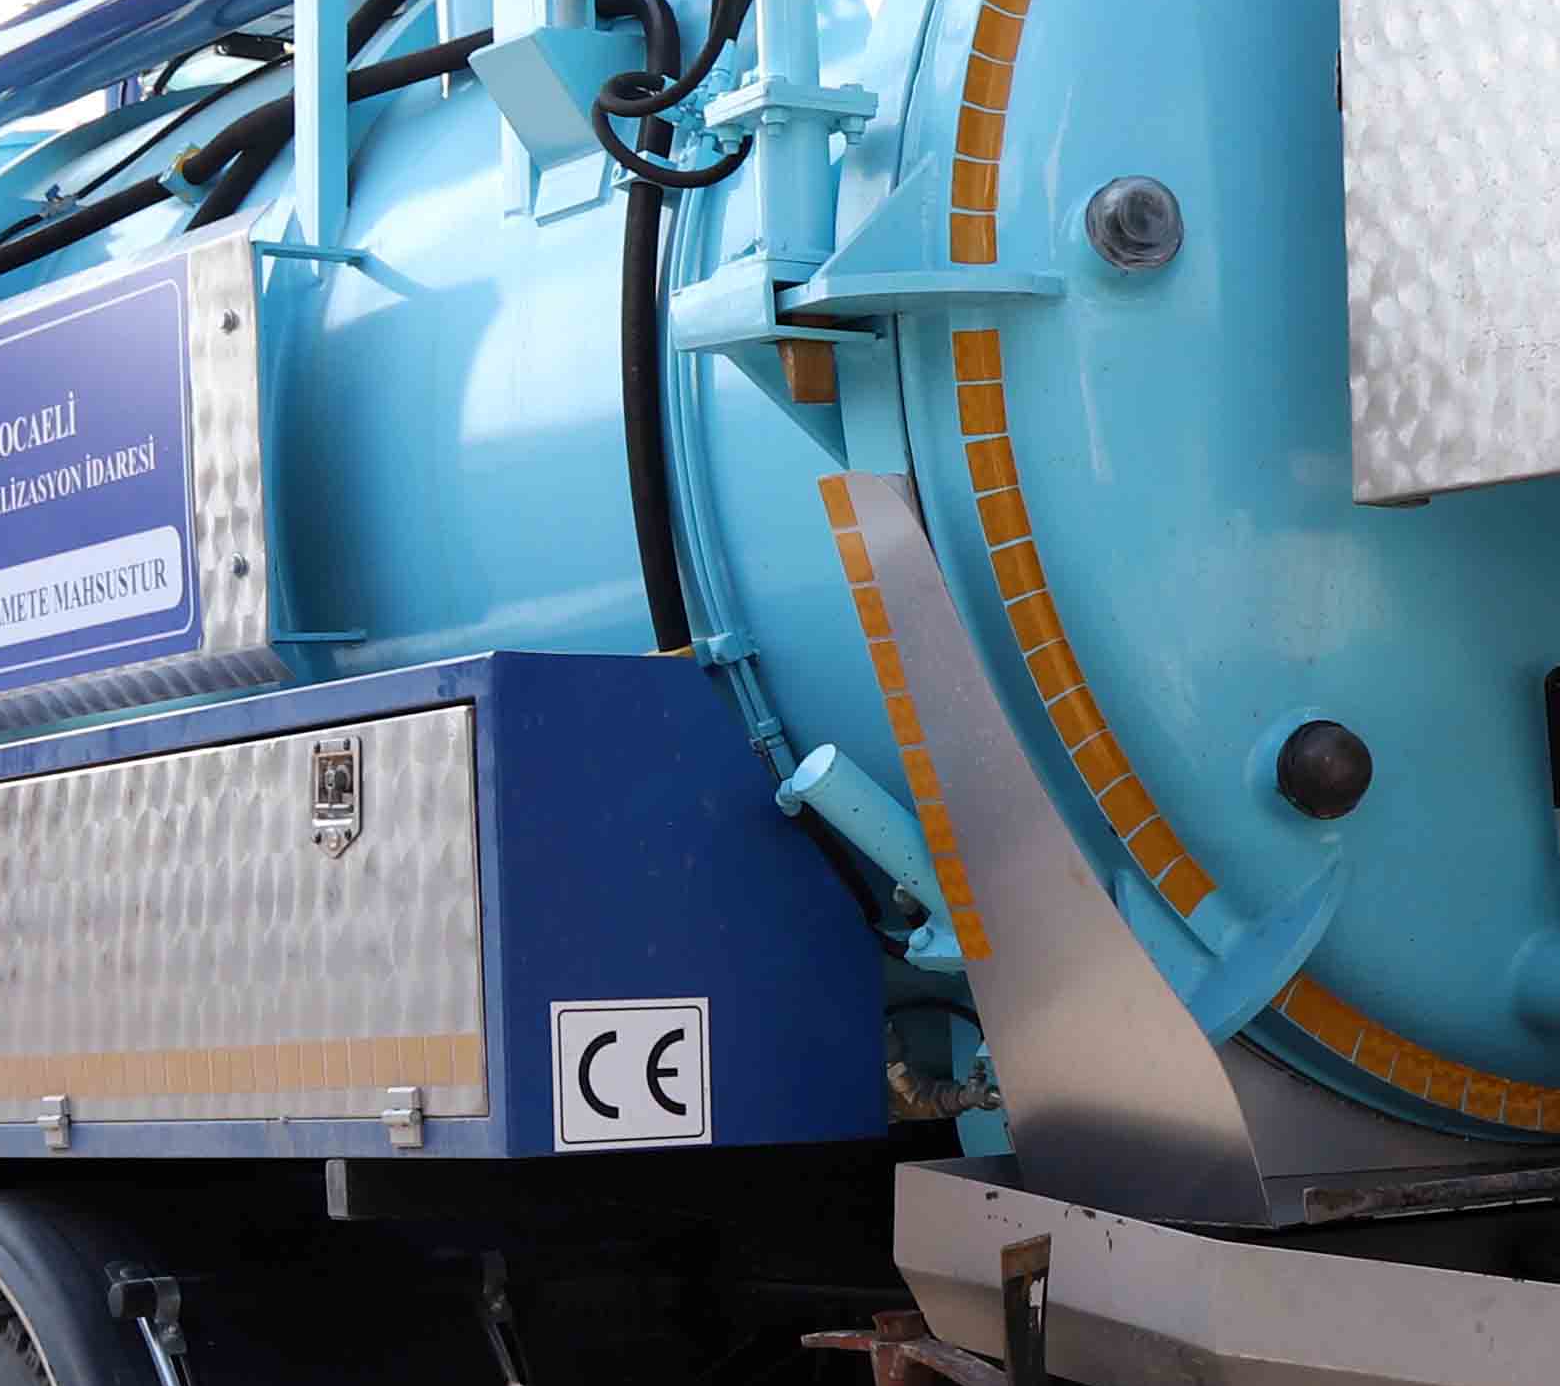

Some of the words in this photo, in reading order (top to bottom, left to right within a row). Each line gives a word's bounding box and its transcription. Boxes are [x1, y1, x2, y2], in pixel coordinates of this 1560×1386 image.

[85, 434, 157, 490] İDARESİ
[53, 558, 168, 613] MAHSUSTUR
[578, 1027, 688, 1120] CE
